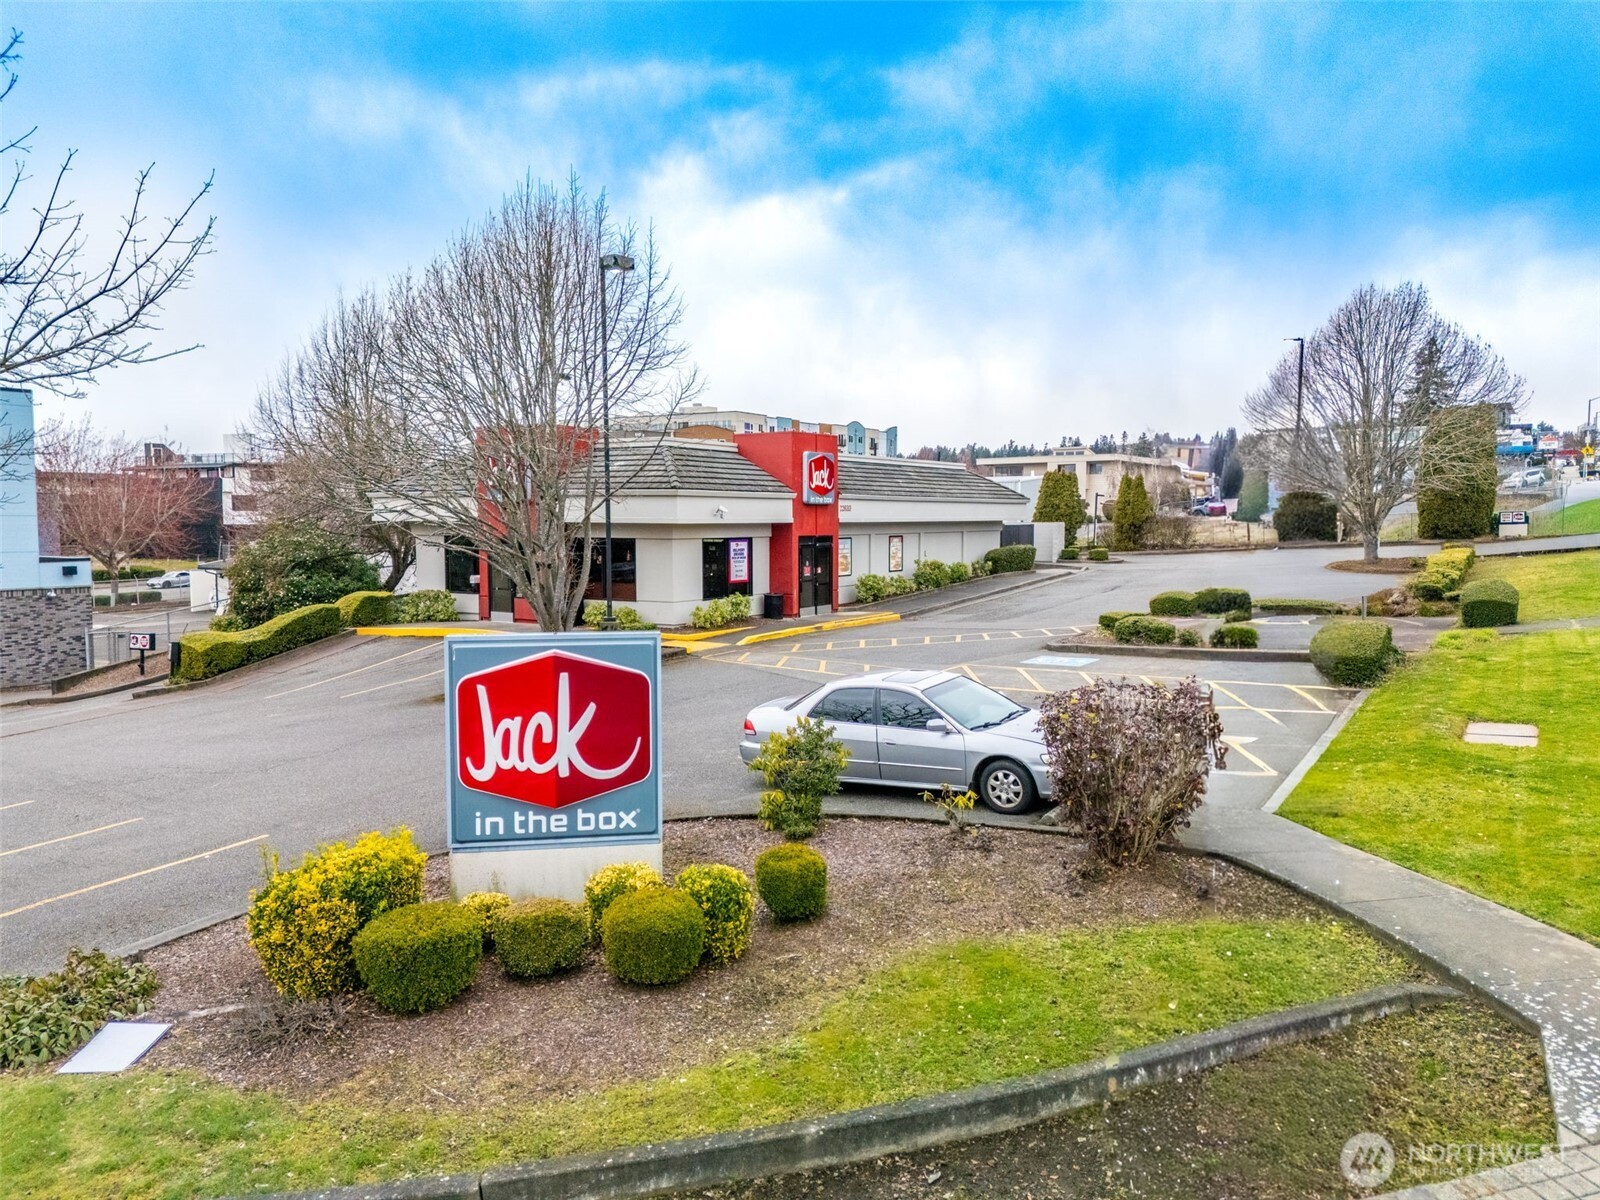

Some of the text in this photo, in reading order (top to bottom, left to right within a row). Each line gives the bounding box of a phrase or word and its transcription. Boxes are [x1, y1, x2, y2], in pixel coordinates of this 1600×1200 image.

[810, 460, 834, 489] Jack
[465, 672, 642, 782] Jack
[475, 811, 504, 836] in
[513, 810, 567, 835] the
